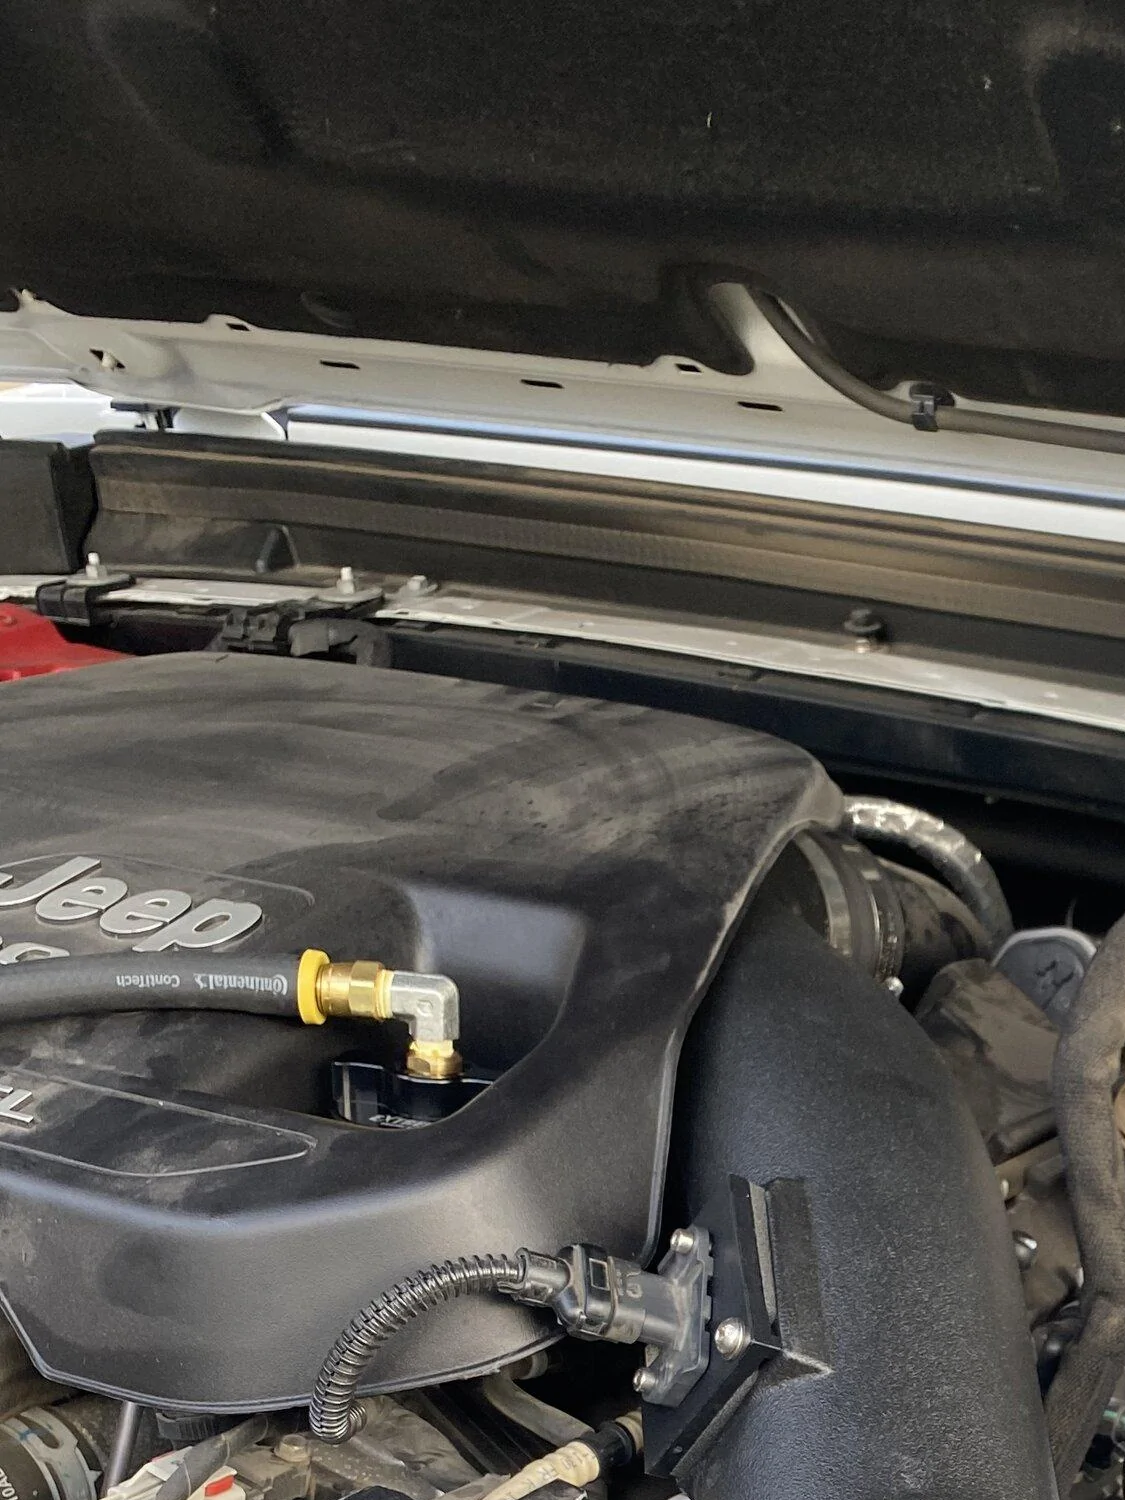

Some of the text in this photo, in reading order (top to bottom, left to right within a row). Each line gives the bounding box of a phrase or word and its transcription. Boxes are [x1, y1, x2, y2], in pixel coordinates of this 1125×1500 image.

[0, 856, 262, 952] Jeep
[116, 973, 289, 996] Continental ContiTech
